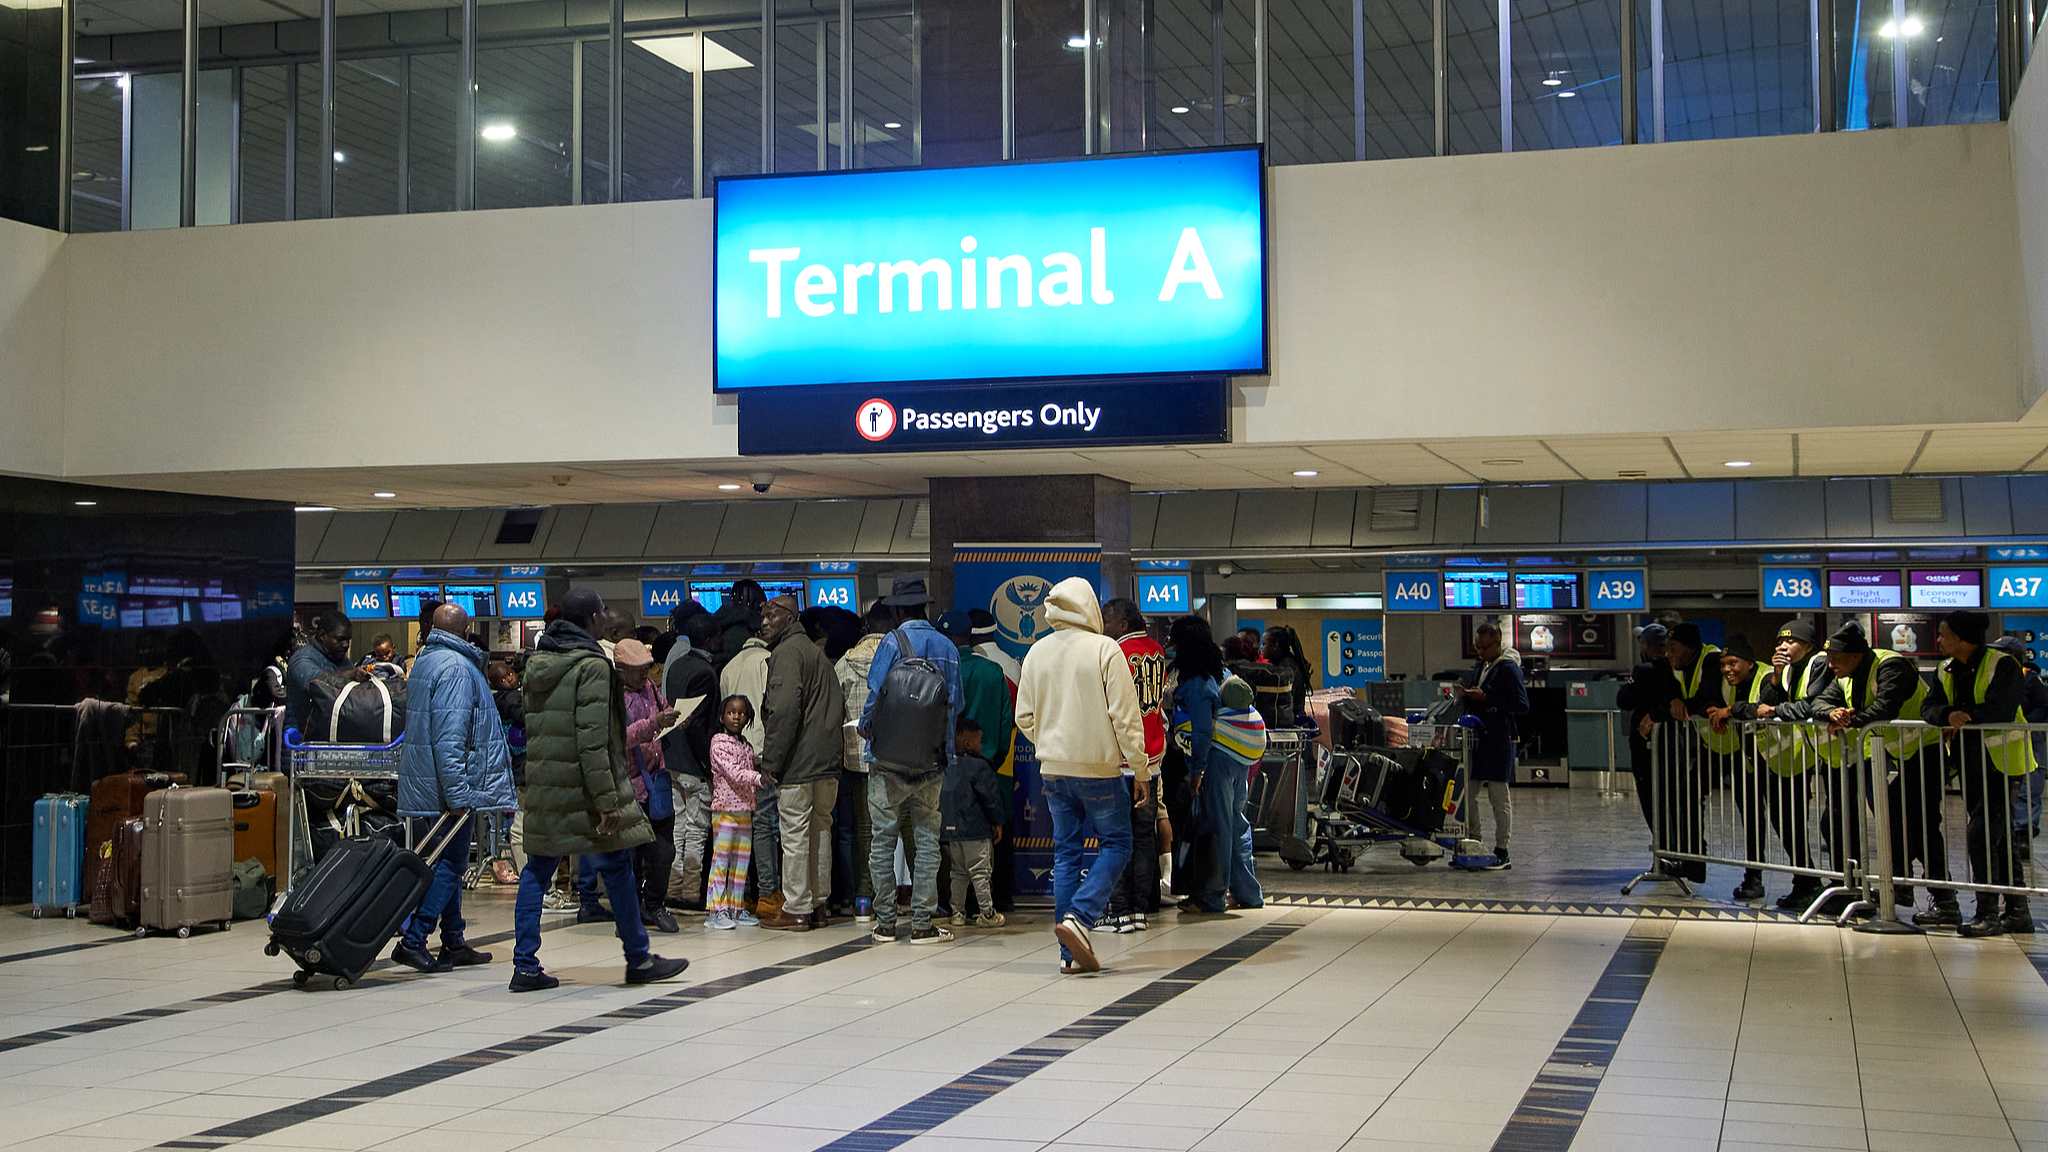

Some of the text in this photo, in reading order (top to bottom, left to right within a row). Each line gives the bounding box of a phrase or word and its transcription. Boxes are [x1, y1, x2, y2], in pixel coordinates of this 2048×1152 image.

[749, 227, 1224, 318] Terminal A
[902, 401, 1101, 434] Passengers Only
[817, 587, 849, 605] A43
[1146, 584, 1180, 603] A41
[1394, 582, 1431, 600] A40
[1597, 580, 1636, 600] A39
[1772, 578, 1813, 598] A38
[1850, 589, 1880, 598] Flight
[1920, 589, 1968, 598] Economy
[1998, 577, 2043, 598] A37
[351, 592, 380, 610] A46
[507, 591, 537, 608] A45
[650, 589, 681, 606] A44
[1839, 596, 1891, 604] Controller
[1930, 596, 1957, 604] Class
